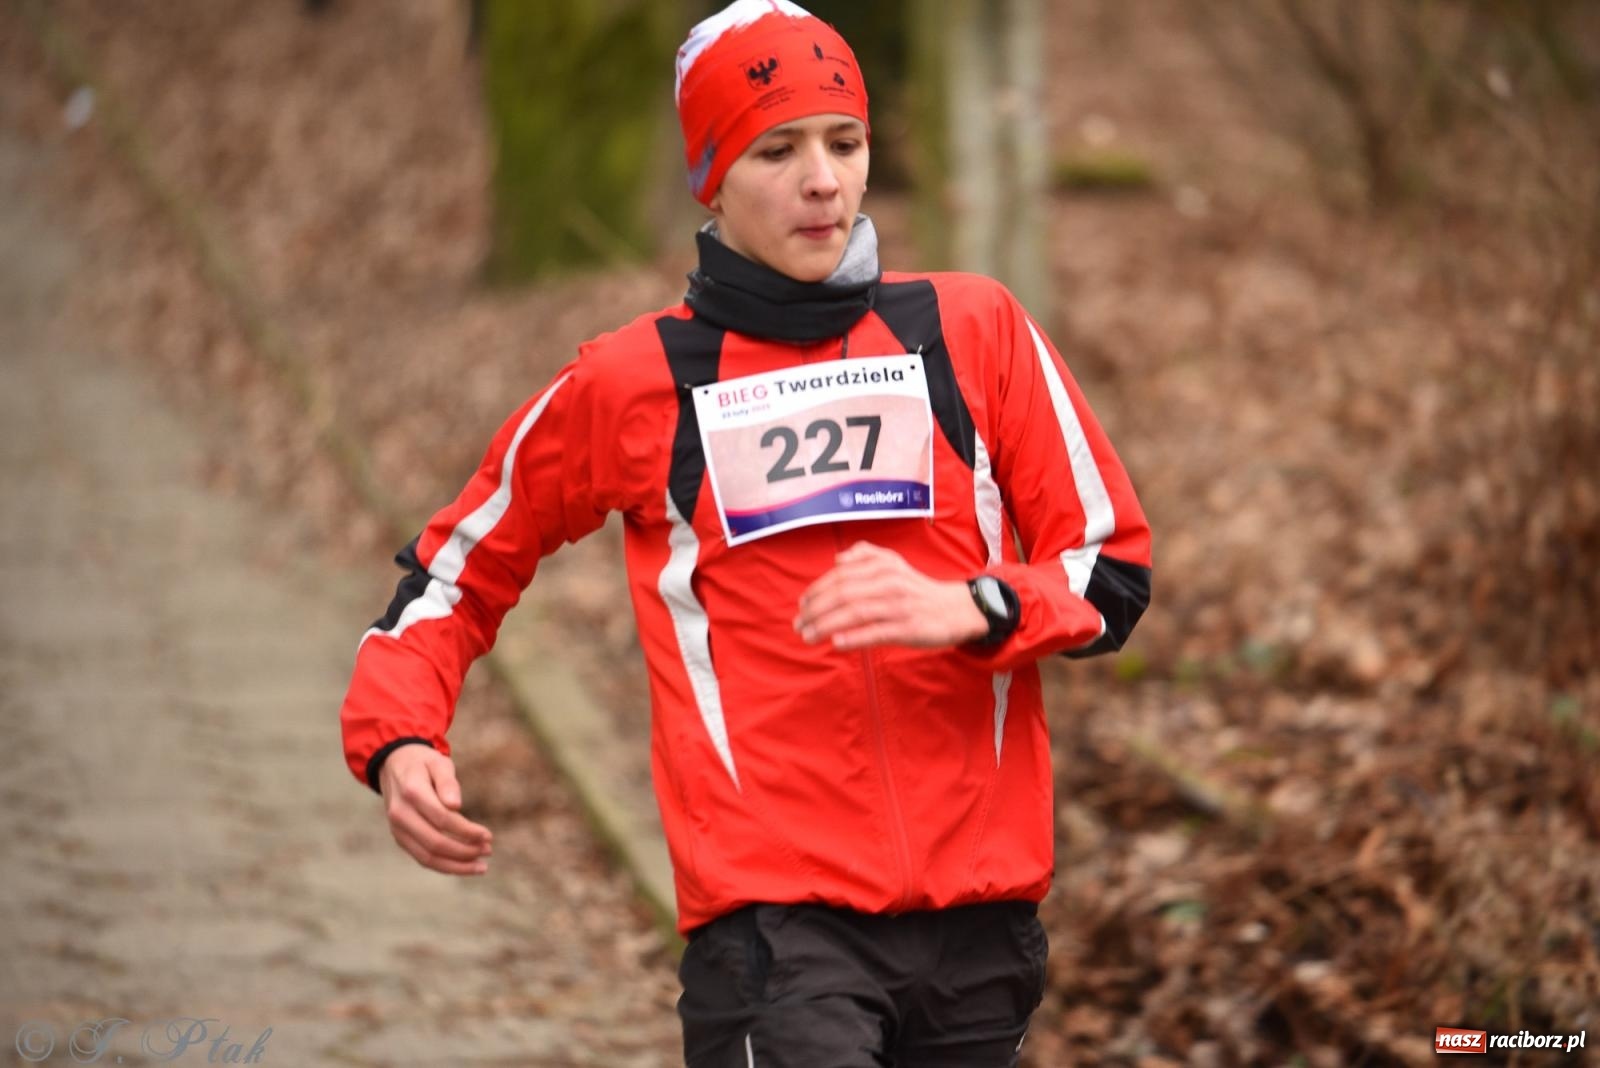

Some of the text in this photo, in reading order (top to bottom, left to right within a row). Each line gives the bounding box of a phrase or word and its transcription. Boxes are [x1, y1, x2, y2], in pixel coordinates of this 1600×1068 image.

[717, 367, 904, 408] BIEG Twardziela
[760, 415, 882, 484] 227
[855, 490, 904, 505] Racibórz
